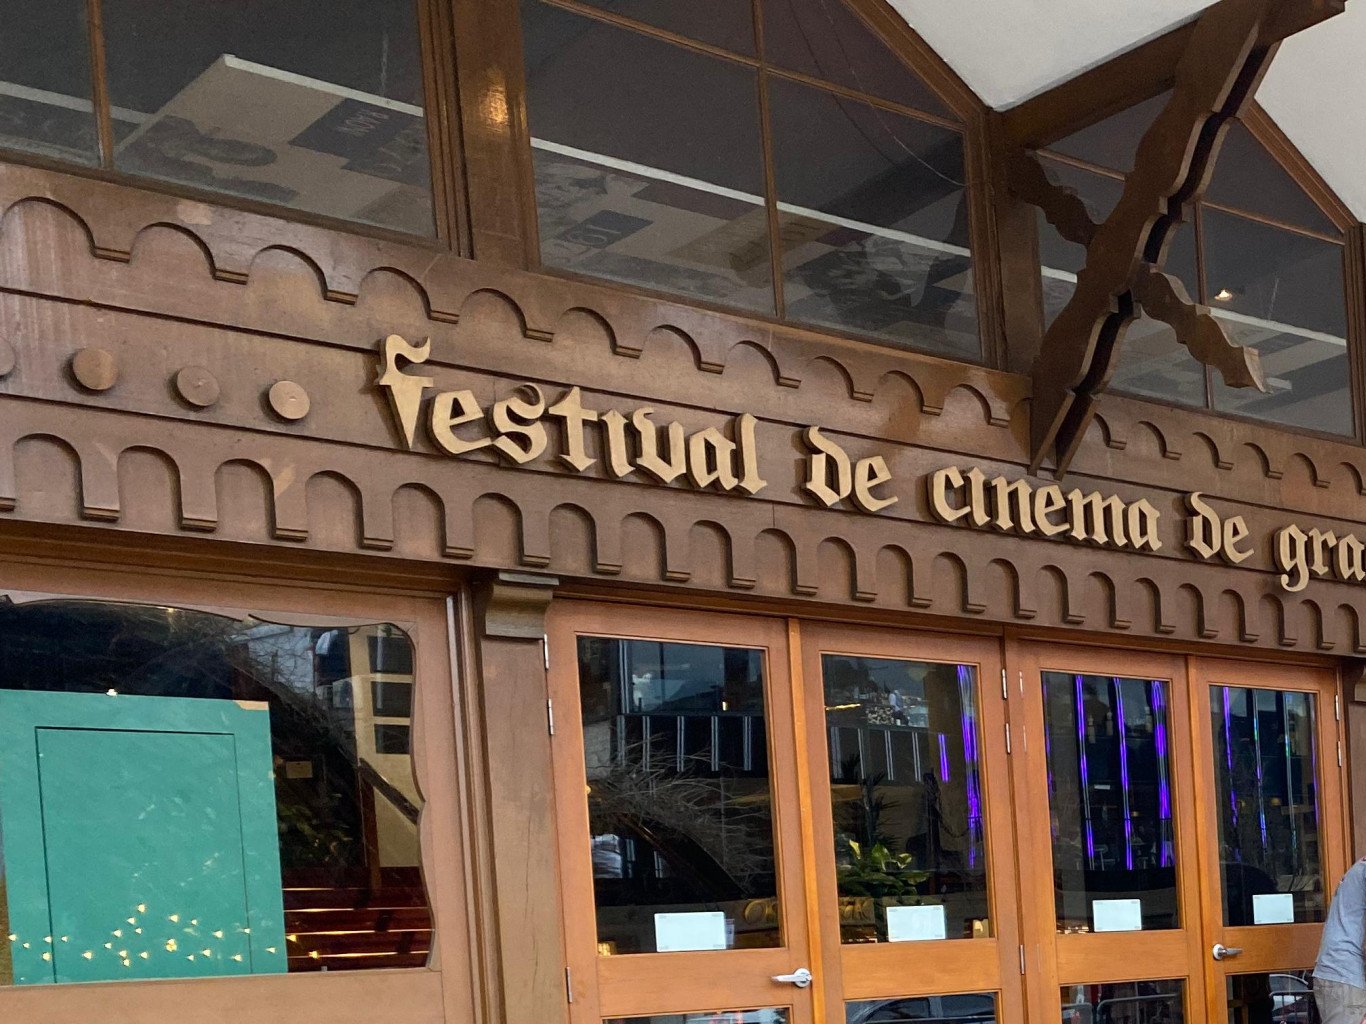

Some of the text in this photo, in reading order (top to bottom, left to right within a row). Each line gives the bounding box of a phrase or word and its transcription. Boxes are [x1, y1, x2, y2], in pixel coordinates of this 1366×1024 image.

[803, 426, 898, 513] de
[930, 465, 1161, 551] cinema
[1187, 491, 1256, 564] de
